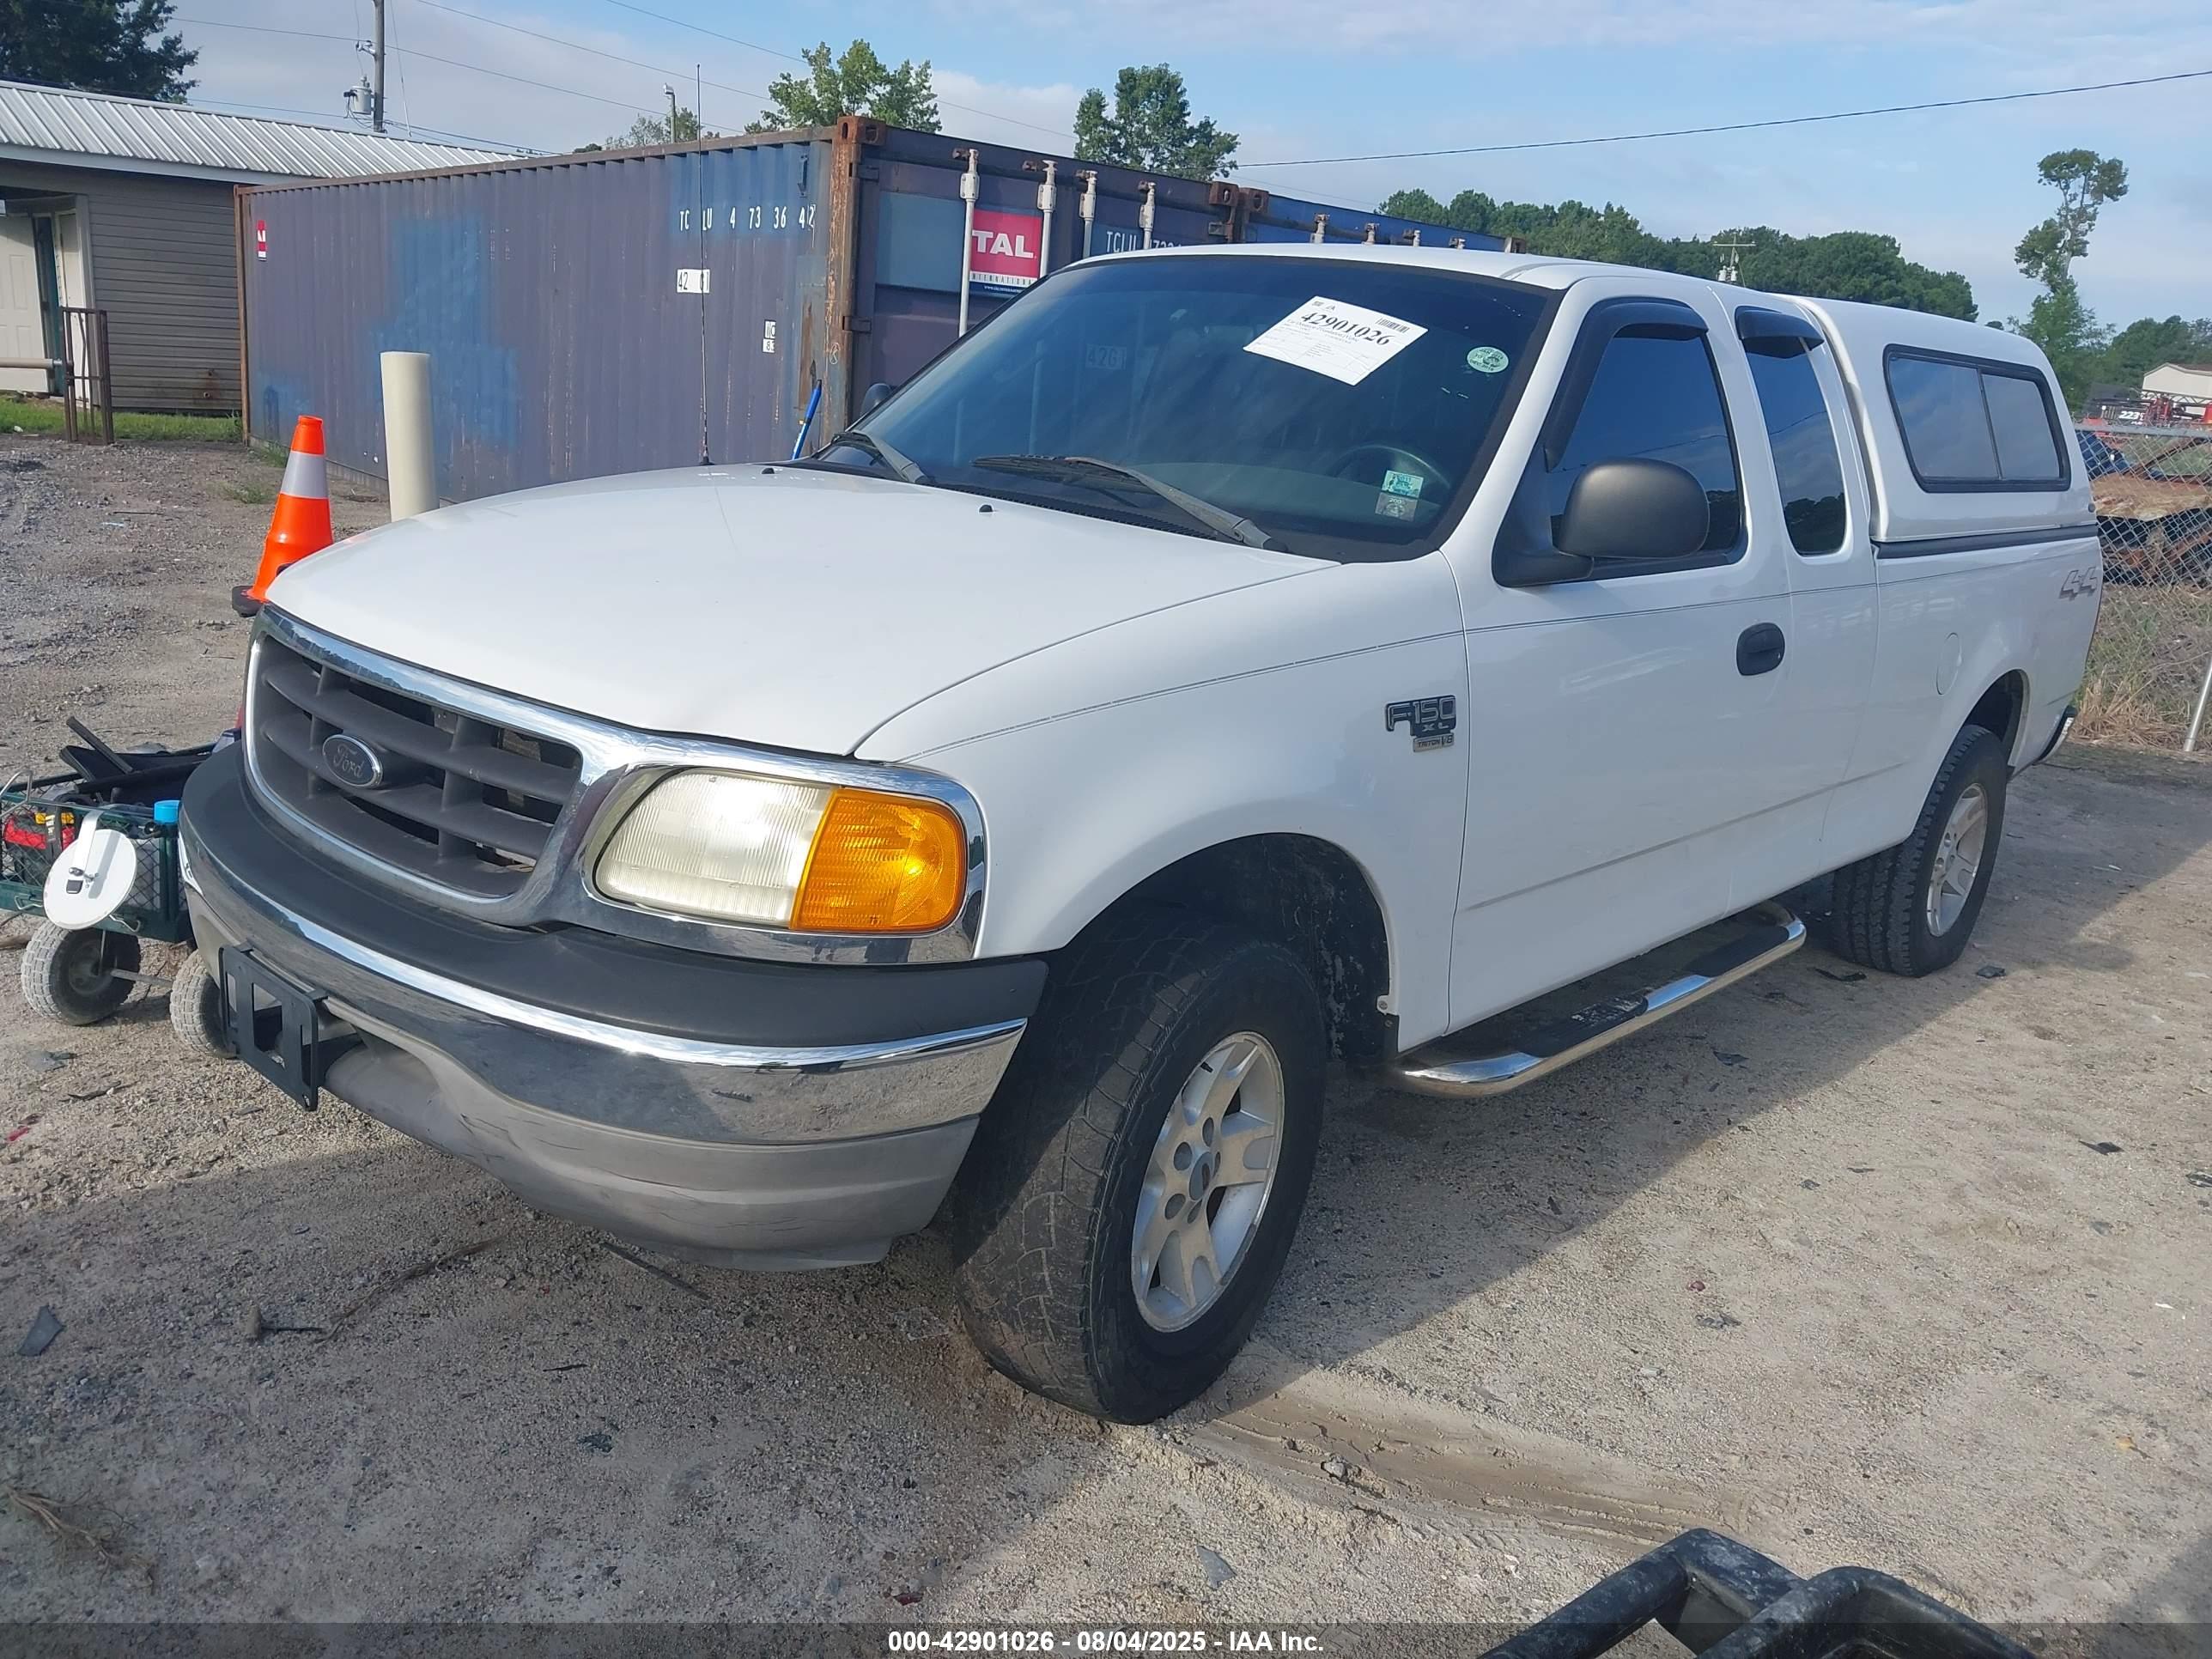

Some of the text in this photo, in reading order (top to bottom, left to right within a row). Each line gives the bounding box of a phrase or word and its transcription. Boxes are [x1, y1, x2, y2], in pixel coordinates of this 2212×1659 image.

[972, 229, 1035, 259] TAL
[1300, 312, 1396, 346] 42901026
[1422, 722, 1449, 732] XL
[332, 744, 366, 778] Ford
